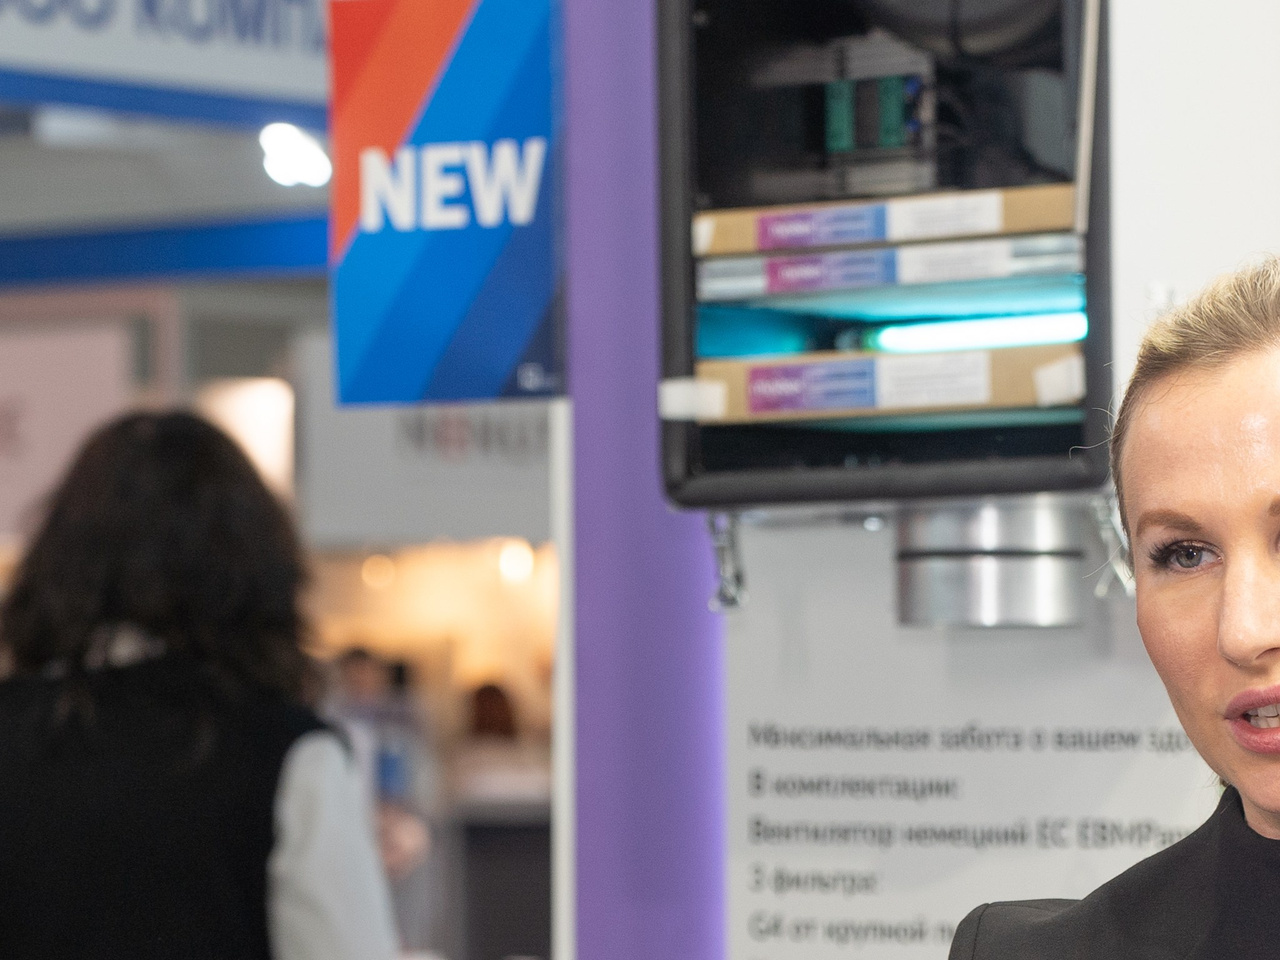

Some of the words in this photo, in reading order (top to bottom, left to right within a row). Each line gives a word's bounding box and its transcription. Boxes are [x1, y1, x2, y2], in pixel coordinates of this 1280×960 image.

[359, 136, 547, 233] NEW
[748, 724, 932, 750] Максимальная
[940, 723, 1025, 750] забота
[1052, 730, 1141, 751] вашем
[749, 816, 896, 847] Вентилятор
[904, 818, 1028, 849] немецкий
[790, 919, 817, 941] от
[823, 914, 928, 945] крупной
